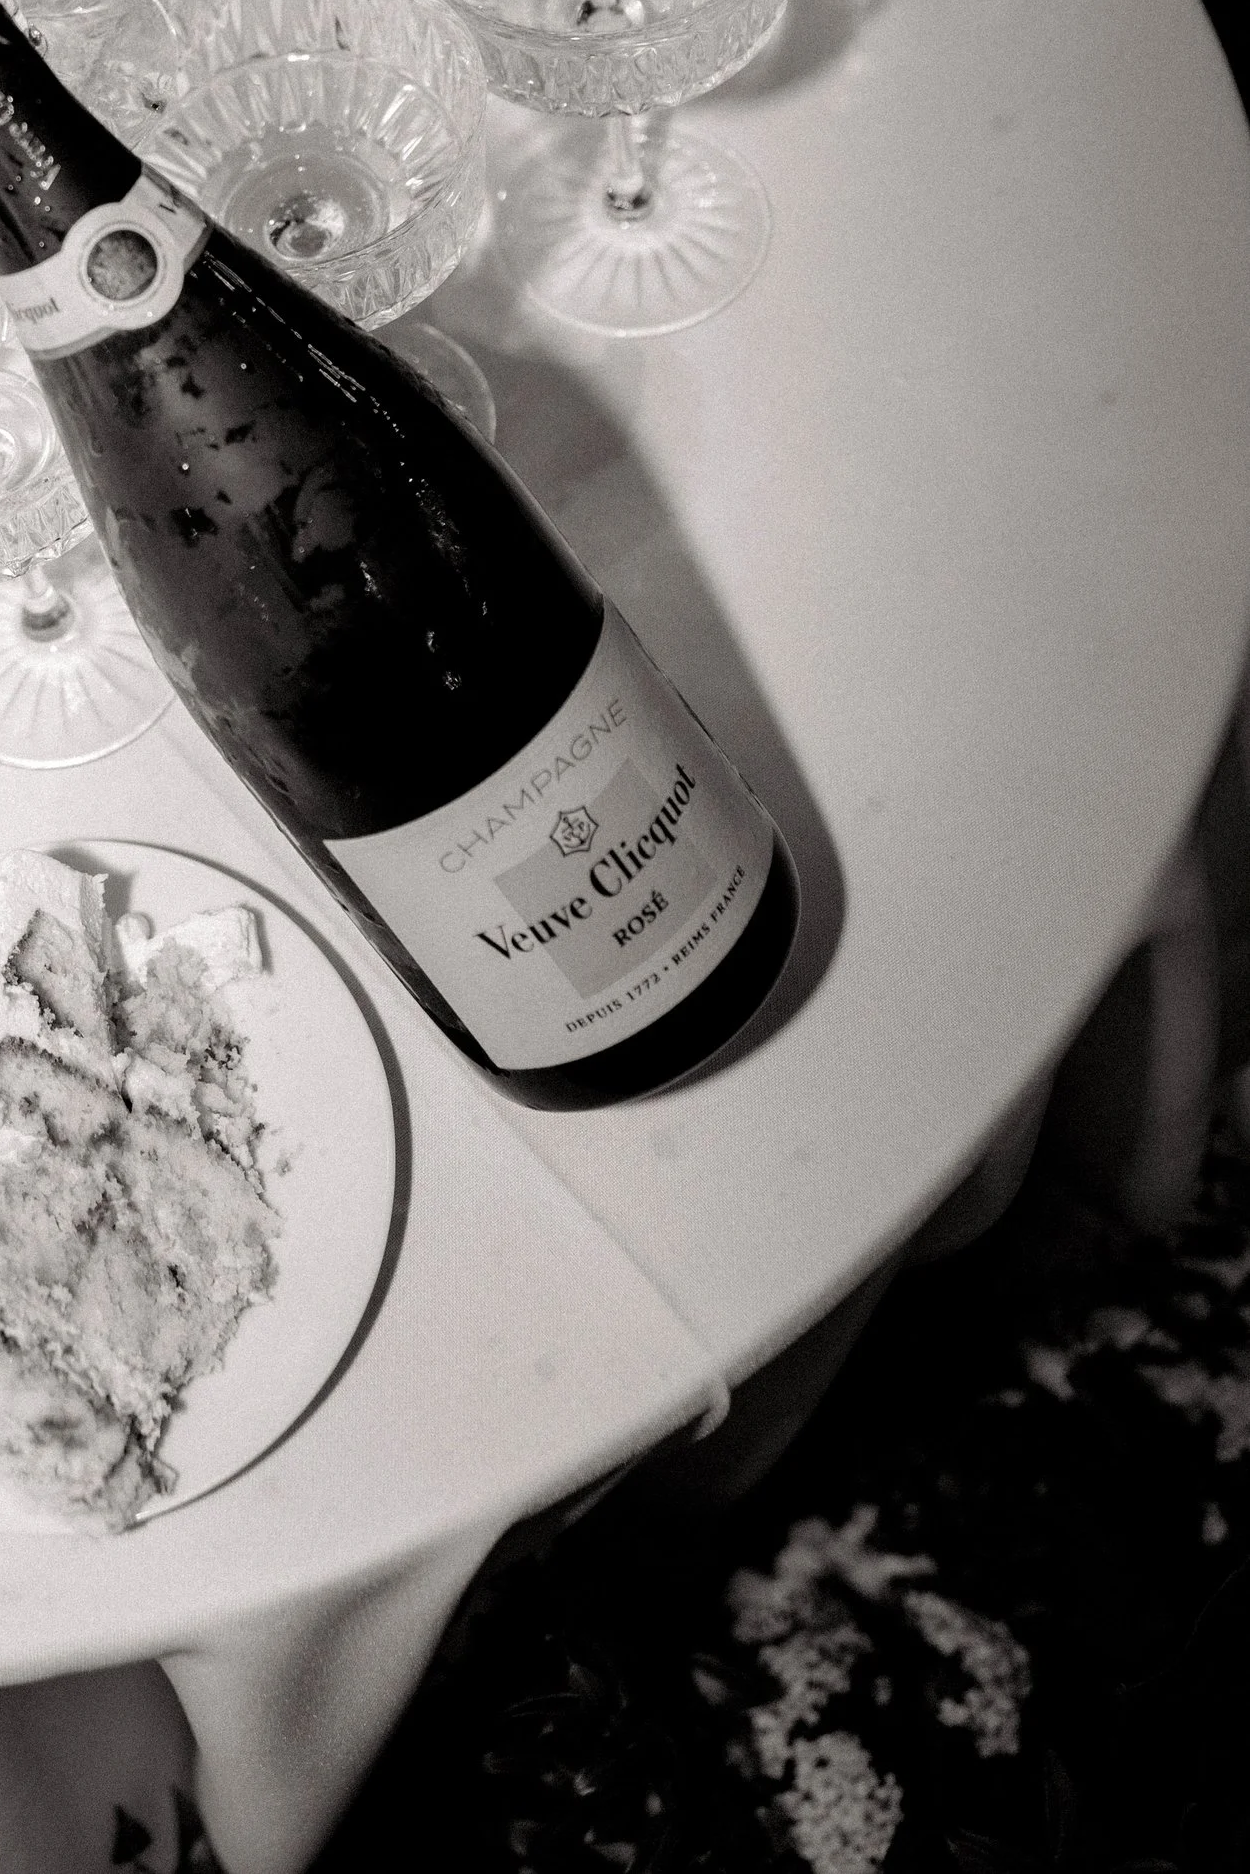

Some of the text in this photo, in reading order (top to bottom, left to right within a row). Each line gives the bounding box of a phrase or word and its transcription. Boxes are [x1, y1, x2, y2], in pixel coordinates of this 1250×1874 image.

[439, 699, 626, 873] CHAMPAGNE
[473, 763, 696, 960] Veuve Clicquot
[565, 865, 746, 1033] DEPUIS 1772 REIMS FRANCE
[612, 889, 670, 948] ROSÉ
